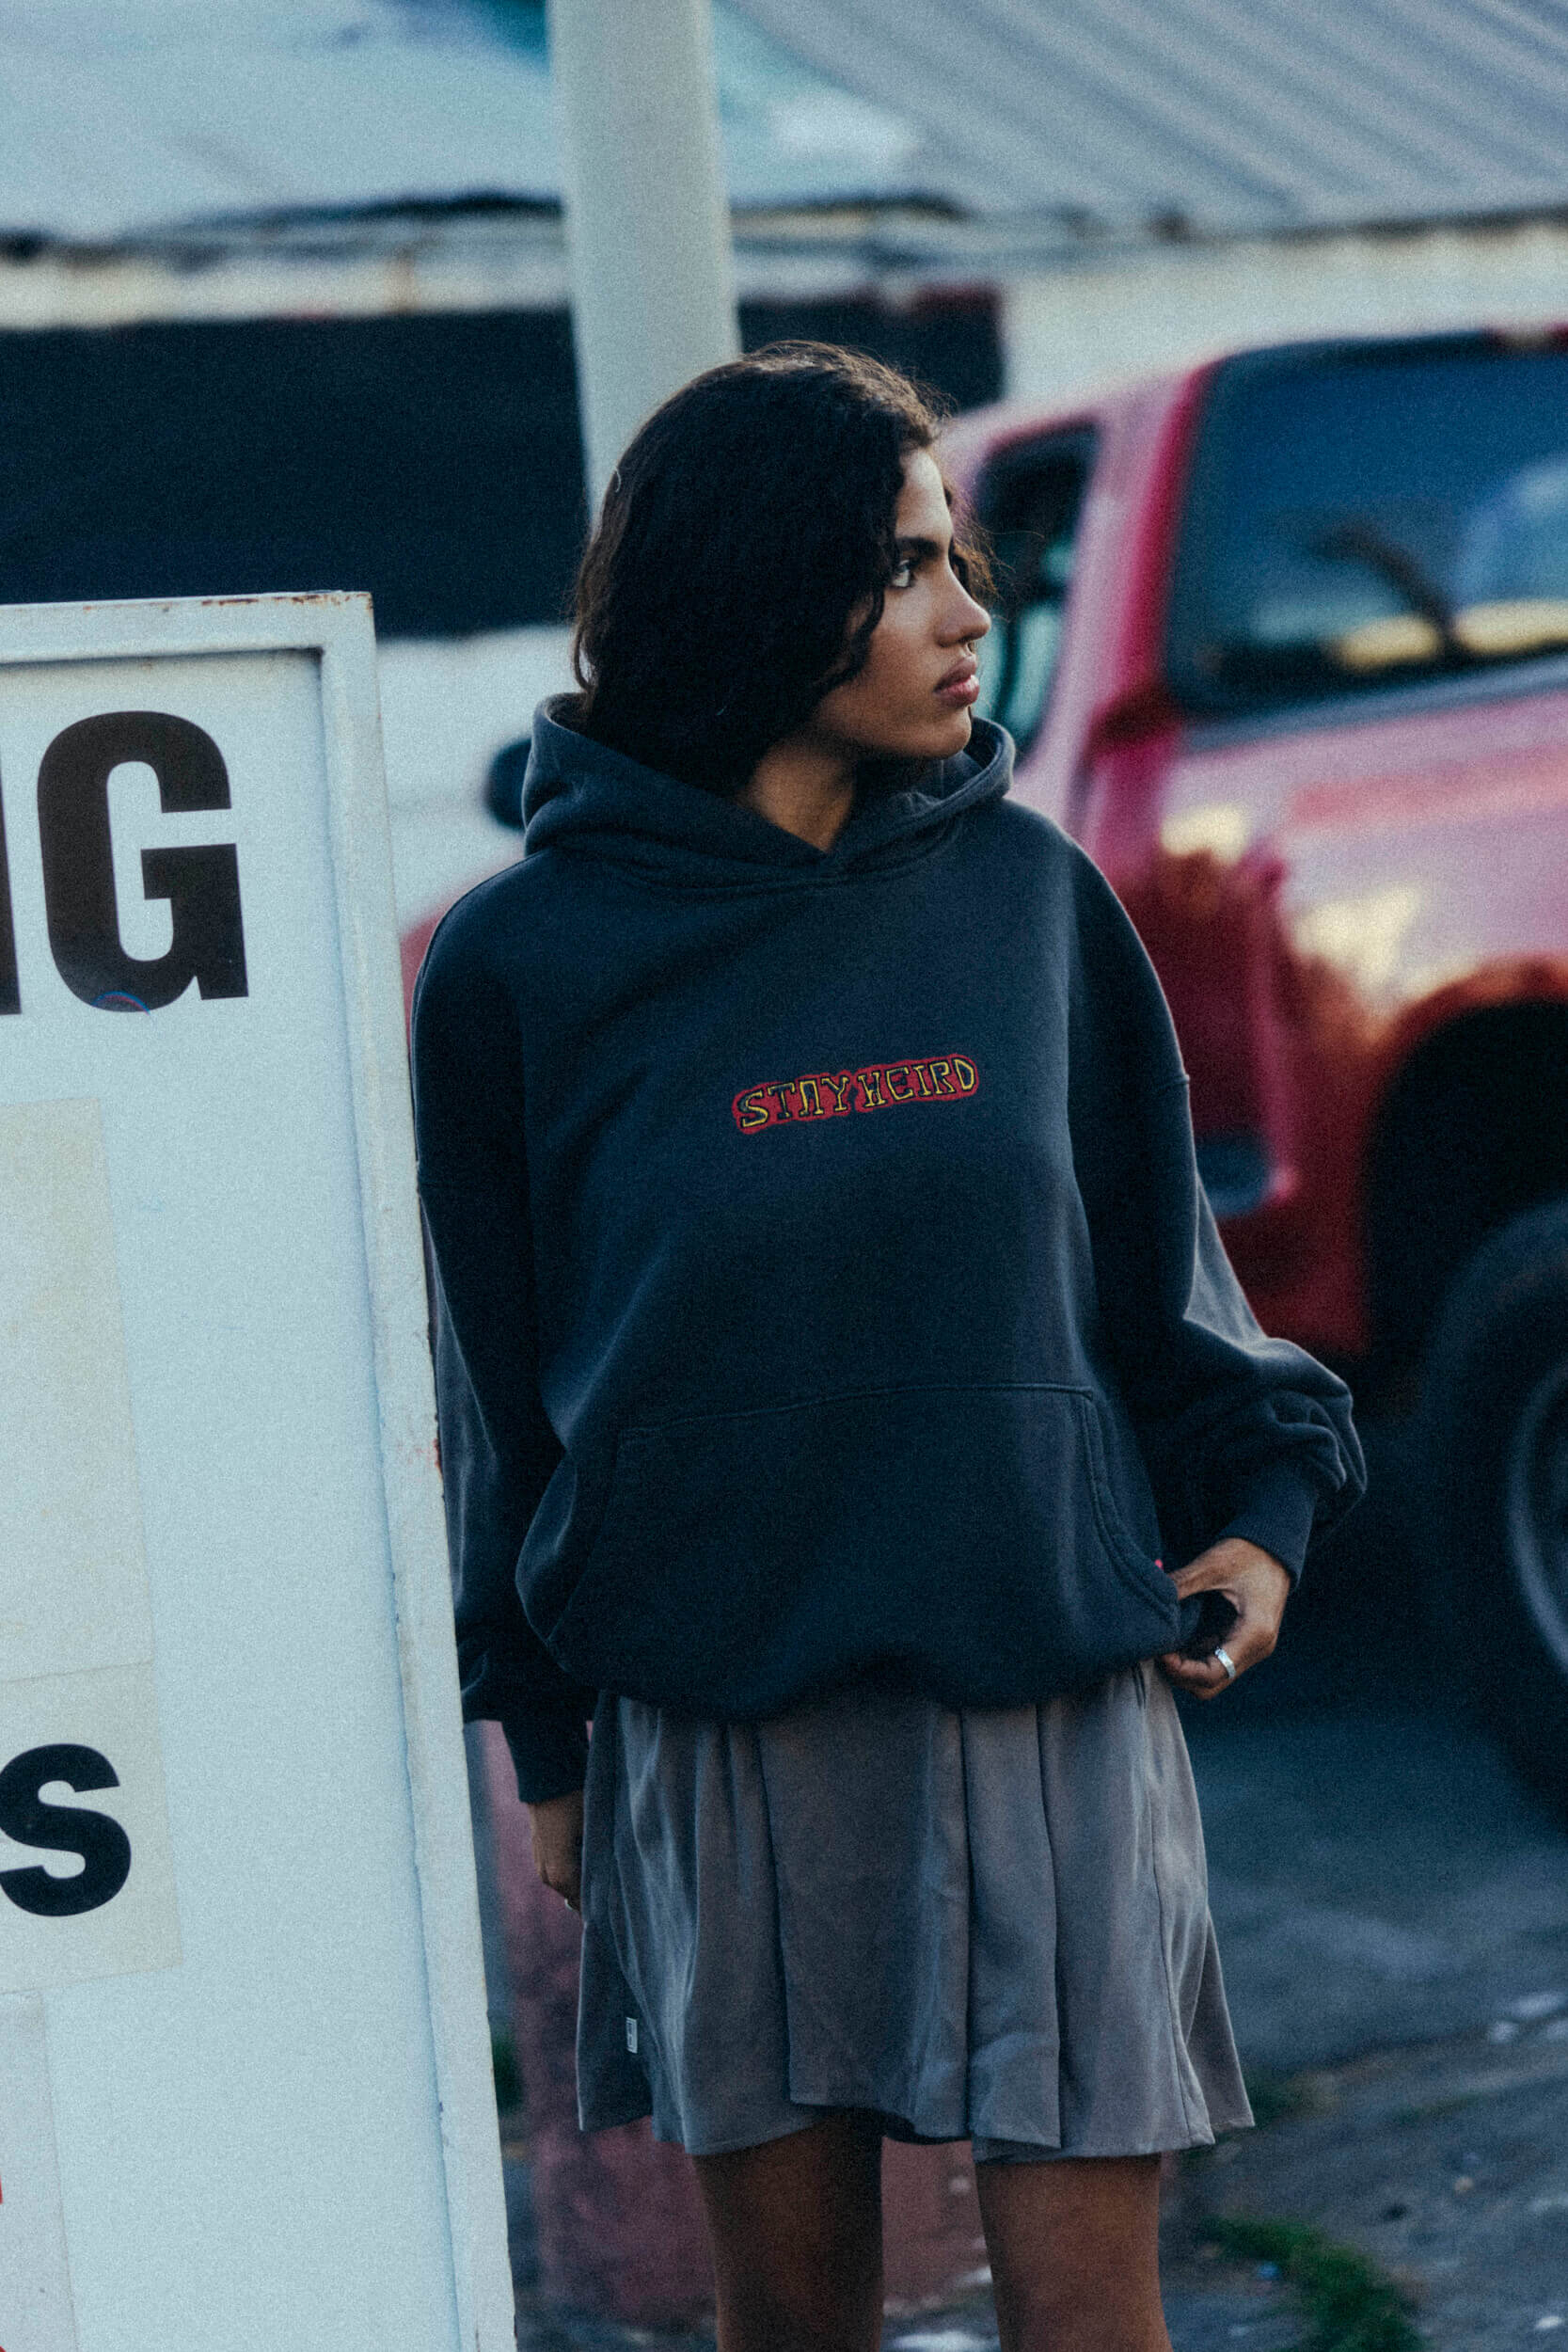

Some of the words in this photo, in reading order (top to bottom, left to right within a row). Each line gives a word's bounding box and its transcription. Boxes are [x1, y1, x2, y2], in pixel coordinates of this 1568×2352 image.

[0, 710, 248, 1015] G
[736, 1075, 850, 1128] STAY
[856, 1056, 976, 1108] WEIRD
